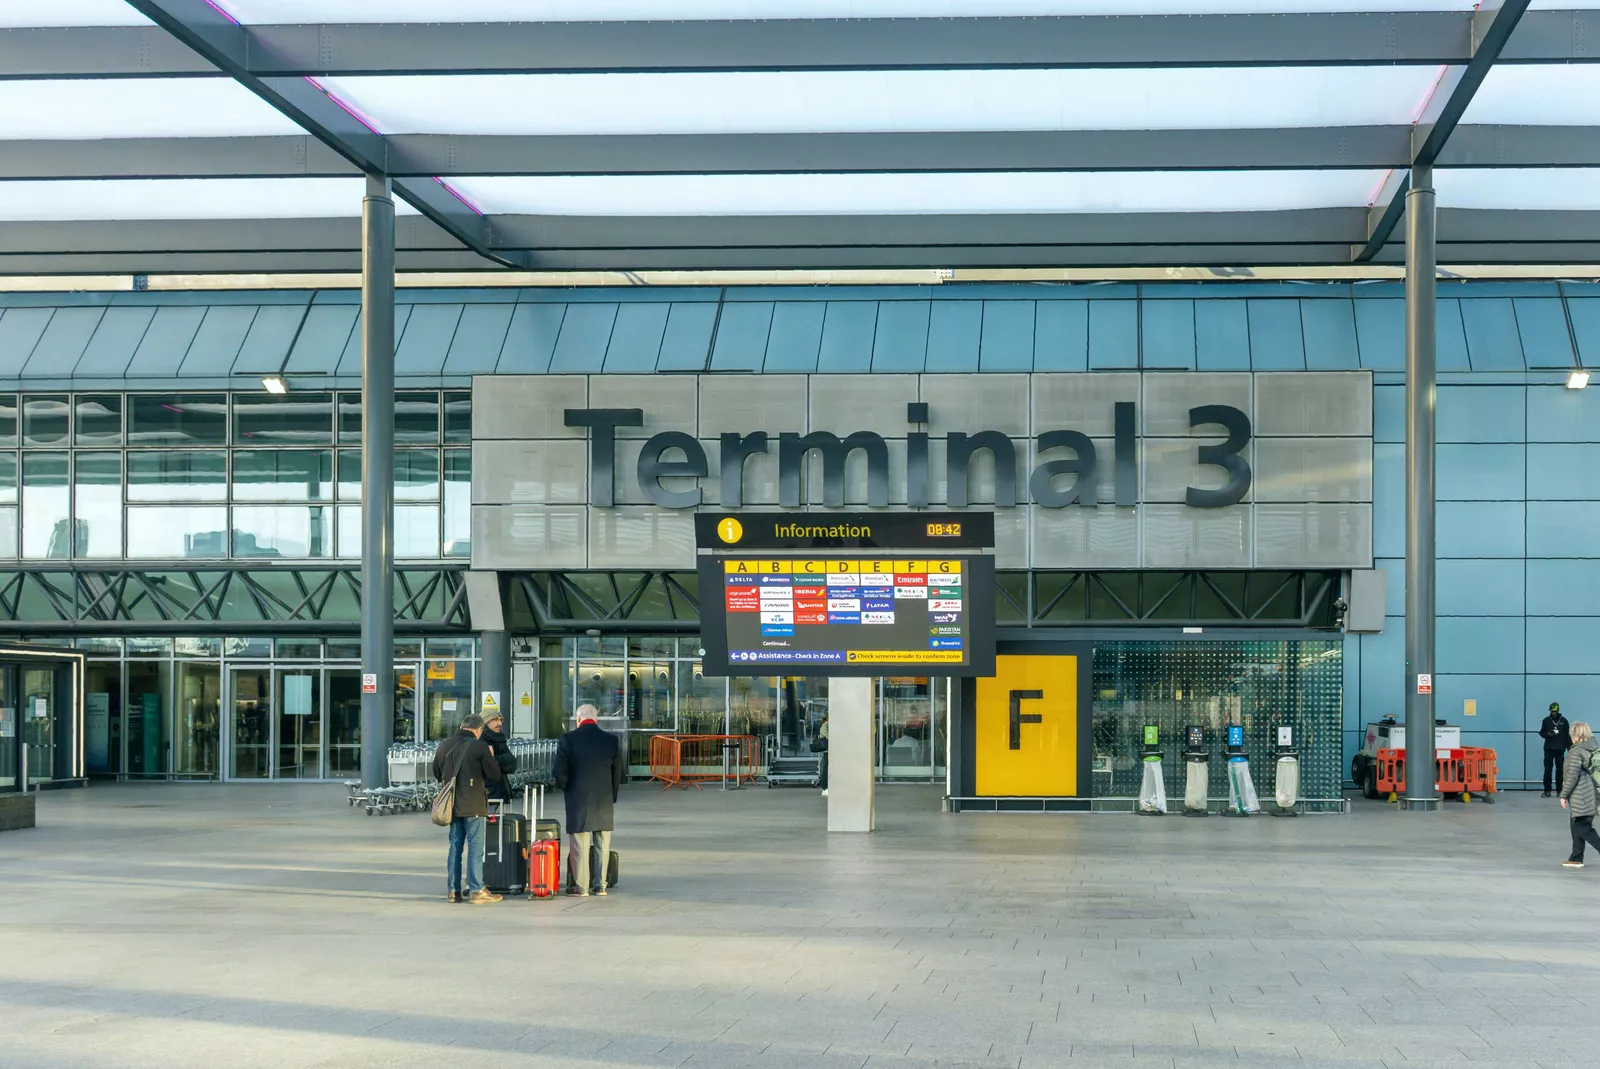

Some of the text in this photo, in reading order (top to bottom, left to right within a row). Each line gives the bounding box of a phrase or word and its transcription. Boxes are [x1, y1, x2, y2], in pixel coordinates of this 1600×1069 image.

[564, 402, 1252, 509] Terminal 3
[774, 523, 871, 538] Information
[927, 524, 961, 536] 08:42
[737, 561, 747, 573] A
[771, 561, 780, 573] B
[805, 561, 814, 573] C
[839, 561, 849, 573] D
[873, 561, 881, 573] E
[908, 561, 915, 573] F
[939, 561, 949, 573] G
[1009, 690, 1044, 750] F
